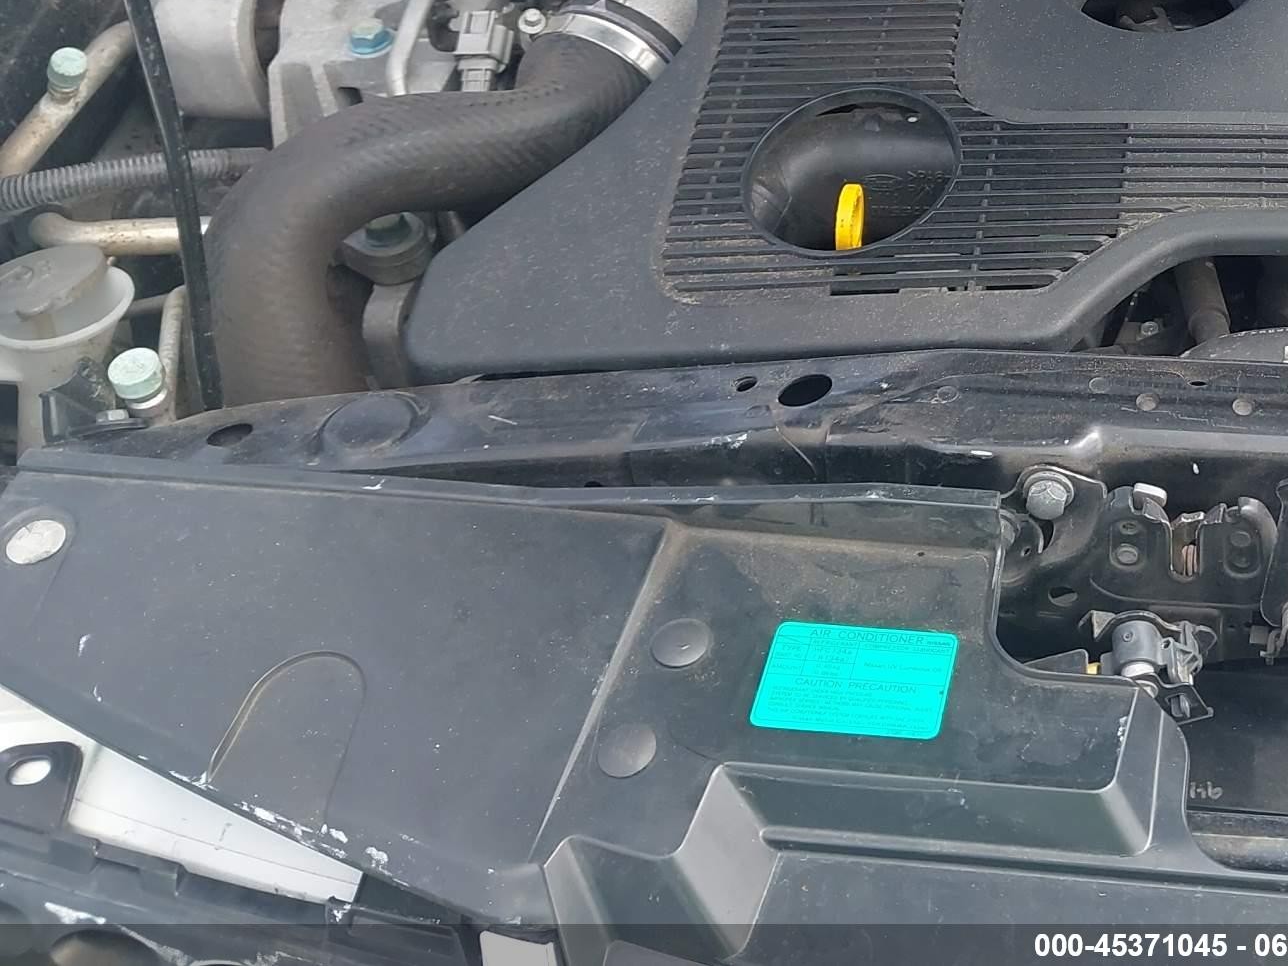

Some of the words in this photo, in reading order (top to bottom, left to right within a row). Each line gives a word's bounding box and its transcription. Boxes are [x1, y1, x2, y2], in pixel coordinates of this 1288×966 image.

[810, 628, 832, 639] AIR
[838, 630, 925, 645] CONDITIONER
[794, 677, 842, 689] CAUTION
[848, 678, 916, 694] PRECAUTION
